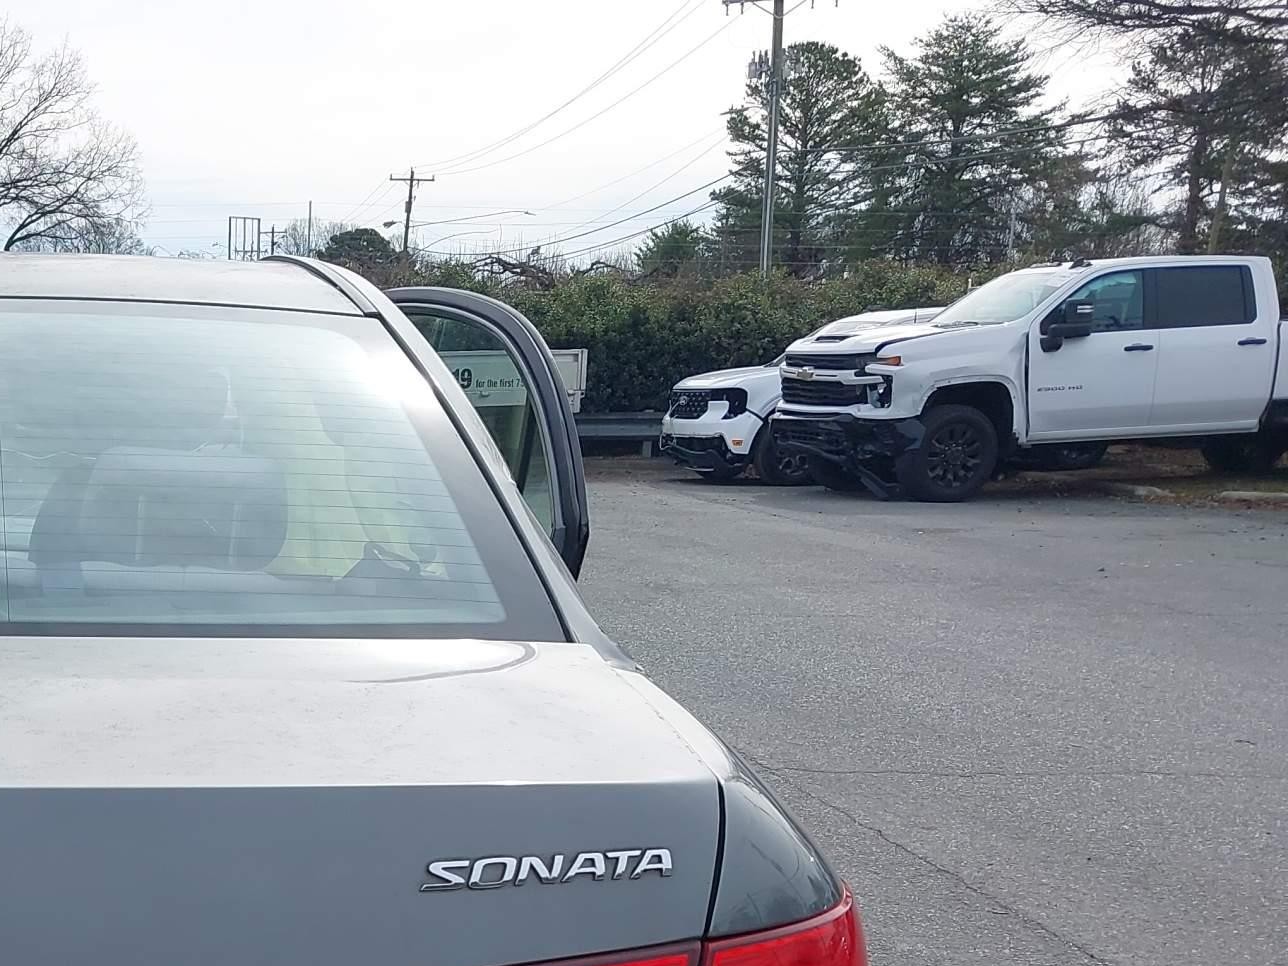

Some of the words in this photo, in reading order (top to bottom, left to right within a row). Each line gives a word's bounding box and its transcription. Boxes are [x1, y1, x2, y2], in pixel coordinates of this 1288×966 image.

[475, 379, 486, 389] for
[486, 378, 498, 388] the
[499, 378, 515, 388] first
[419, 848, 673, 892] SONATA
